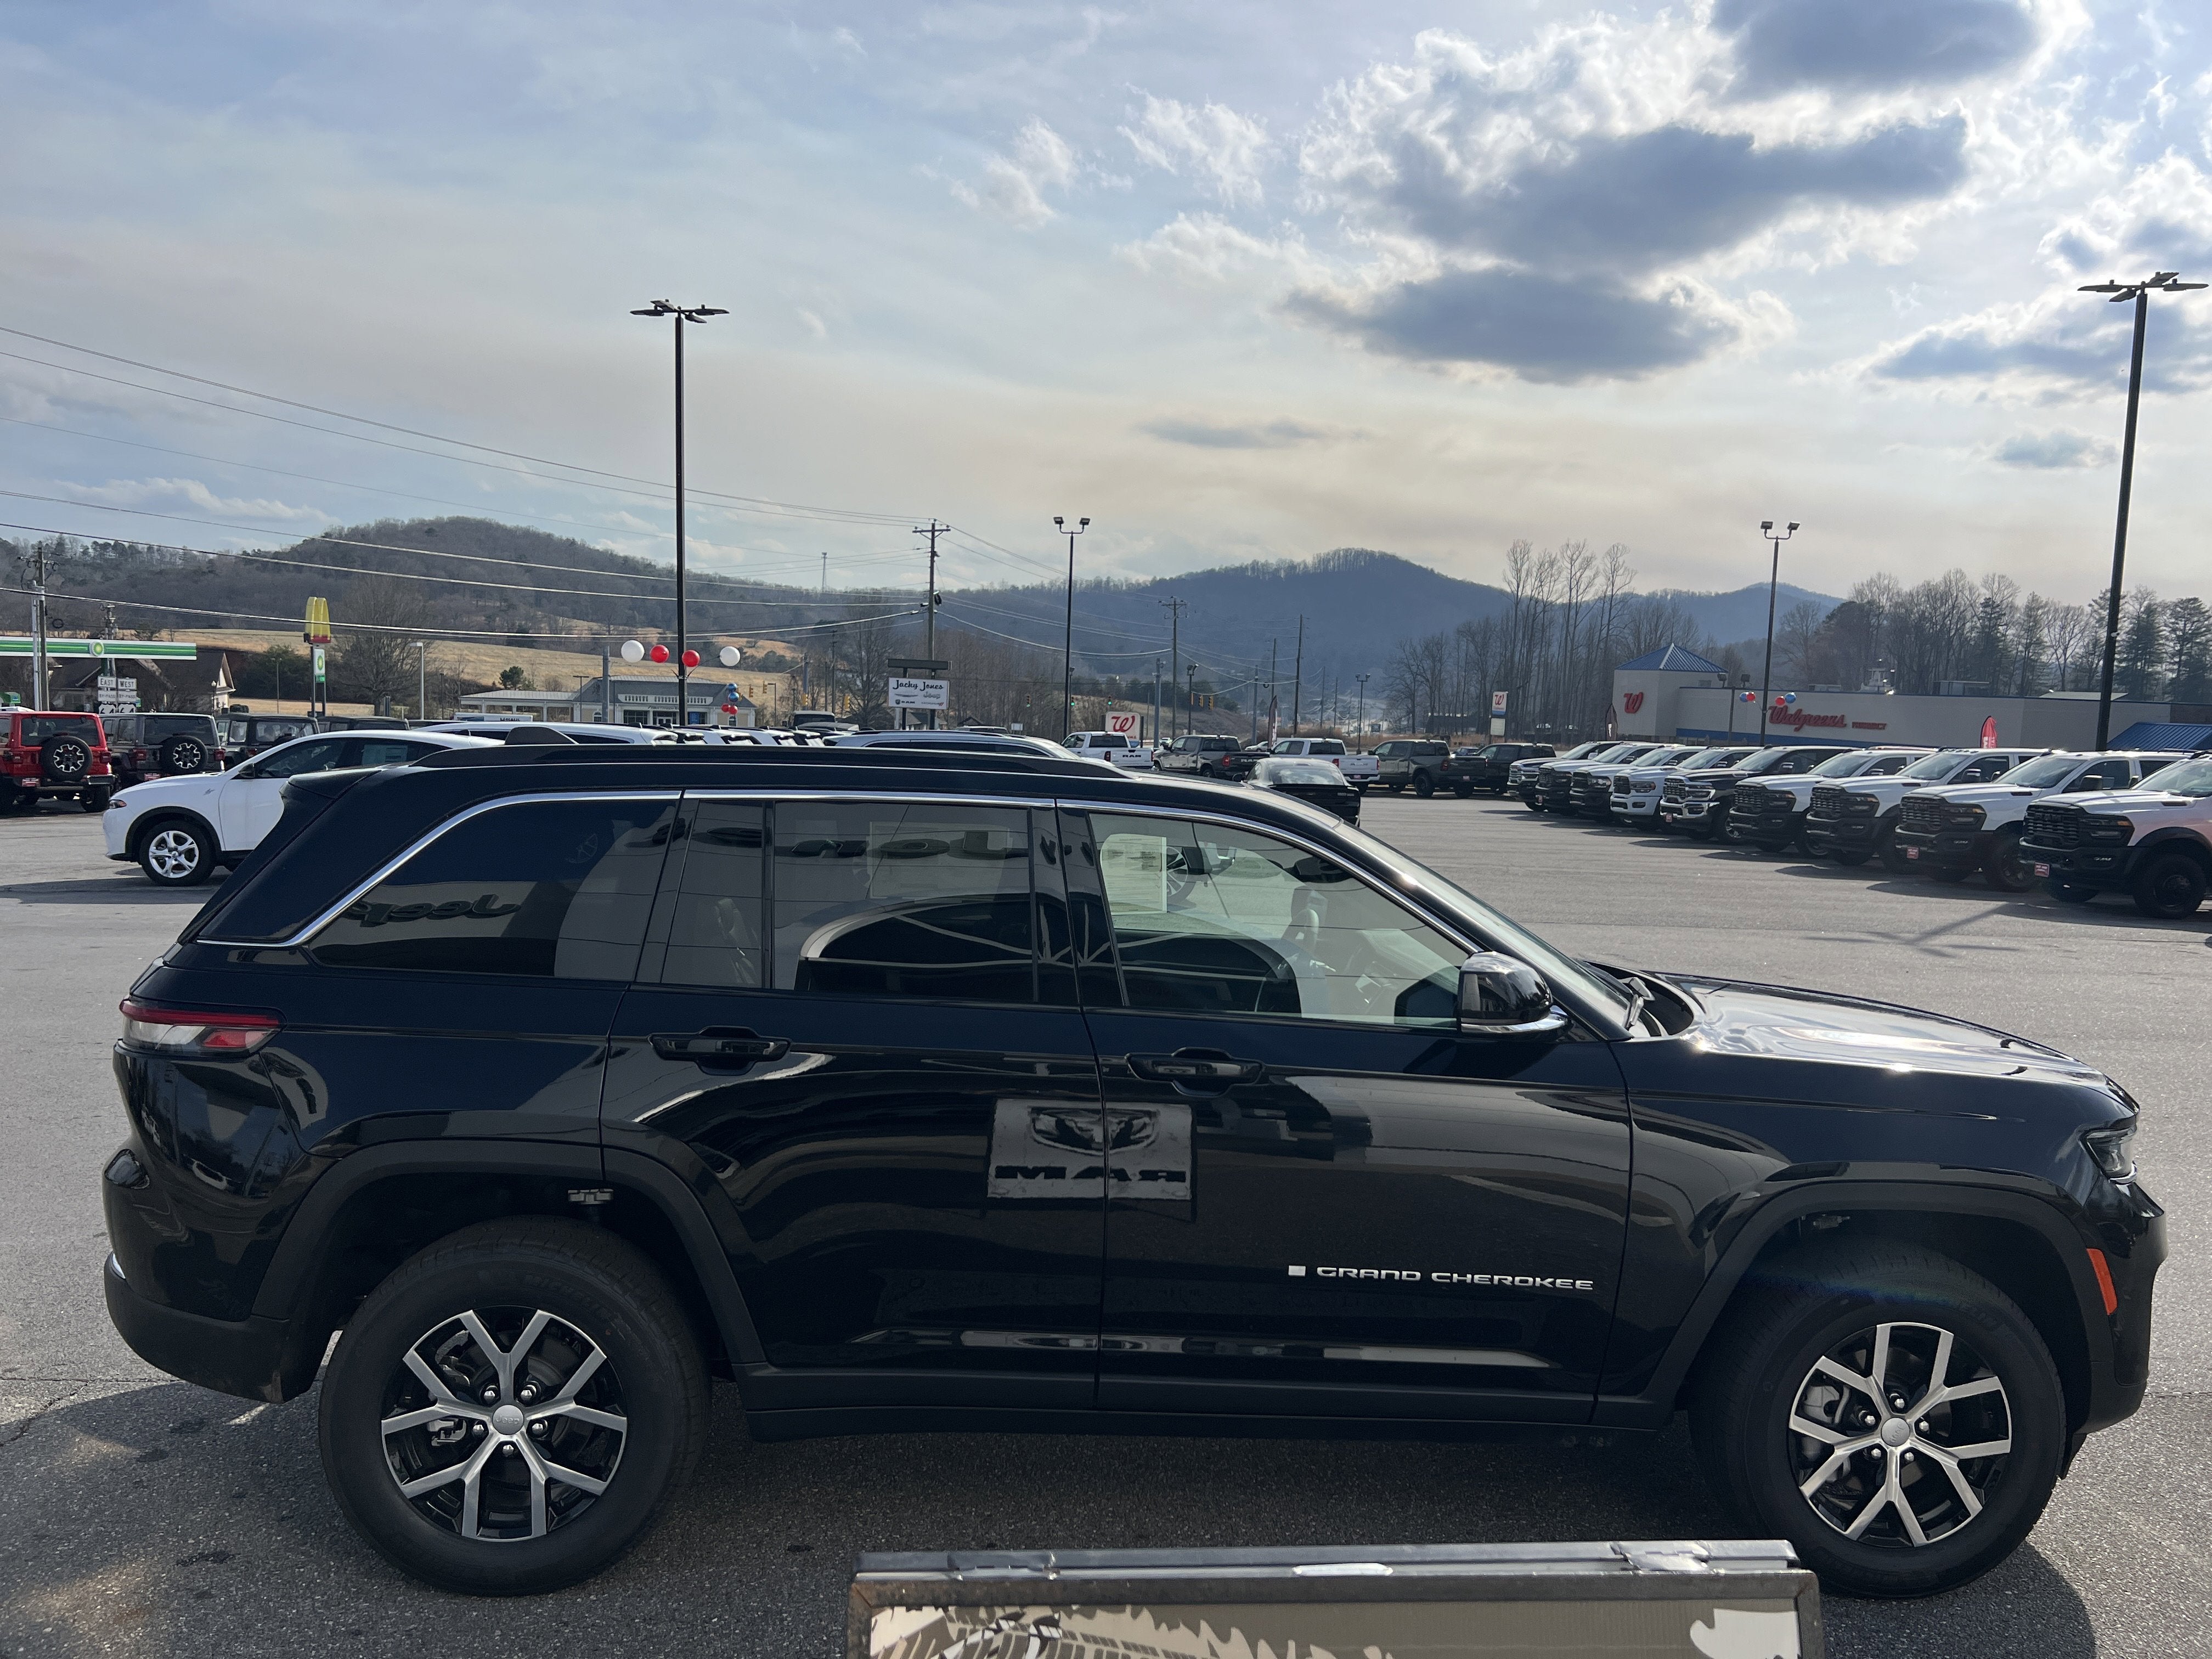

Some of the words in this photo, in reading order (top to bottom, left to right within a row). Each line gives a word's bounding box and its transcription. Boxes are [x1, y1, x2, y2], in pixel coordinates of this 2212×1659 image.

[893, 680, 918, 690] Jacky
[919, 681, 944, 691] Jones
[1495, 694, 1504, 705] W
[1624, 692, 1644, 714] W
[1111, 715, 1135, 732] W
[1769, 705, 1847, 732] Walgreens
[1317, 1266, 1421, 1281] GRAND
[1430, 1272, 1594, 1290] CHEROKEE
[496, 1415, 520, 1424] Jeep
